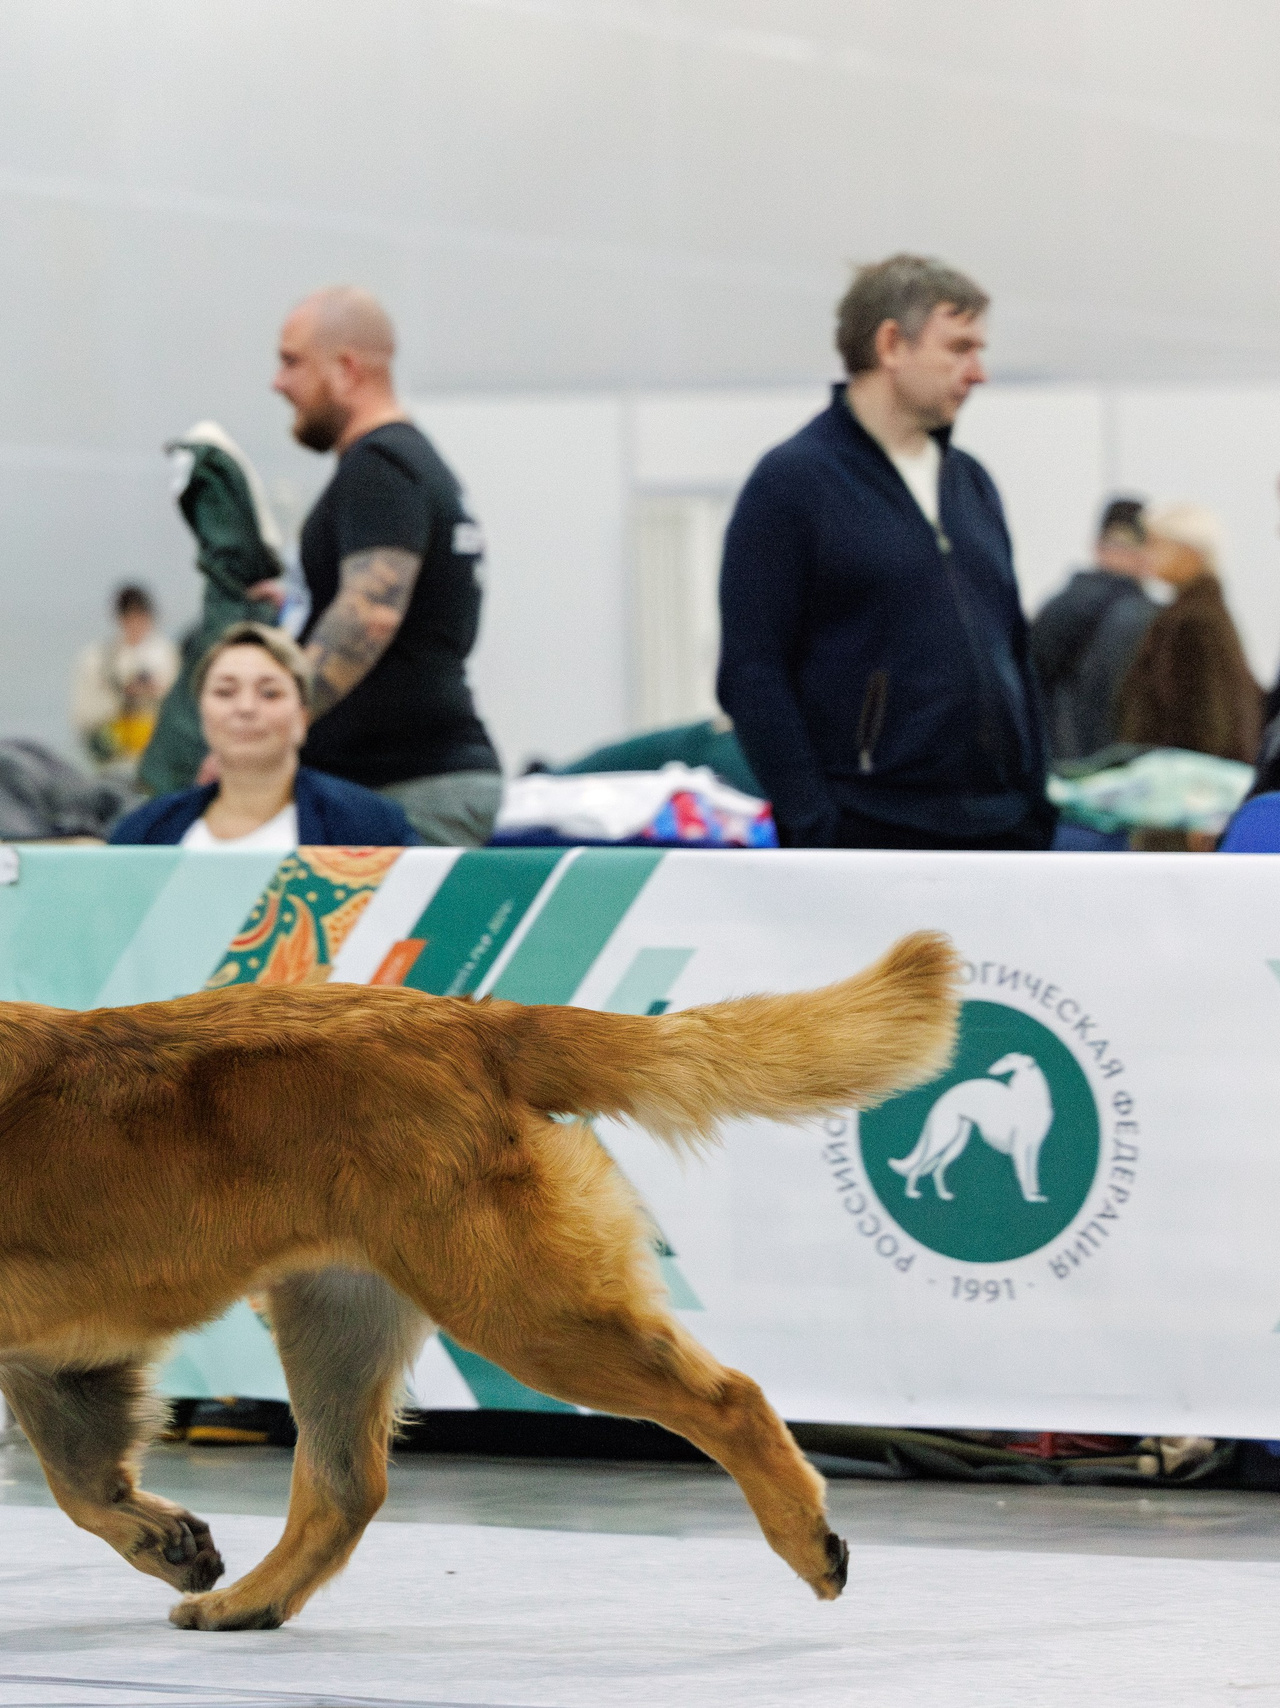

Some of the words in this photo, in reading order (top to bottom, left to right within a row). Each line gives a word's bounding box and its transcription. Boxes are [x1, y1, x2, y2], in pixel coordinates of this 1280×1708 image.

[821, 1117, 917, 1273] РОССИЙС
[956, 961, 1125, 1079] ОГИЧЕСКАЯ
[1048, 1089, 1140, 1280] ФЕДЕРАЦИЯ
[951, 1275, 1017, 1302] 1991
